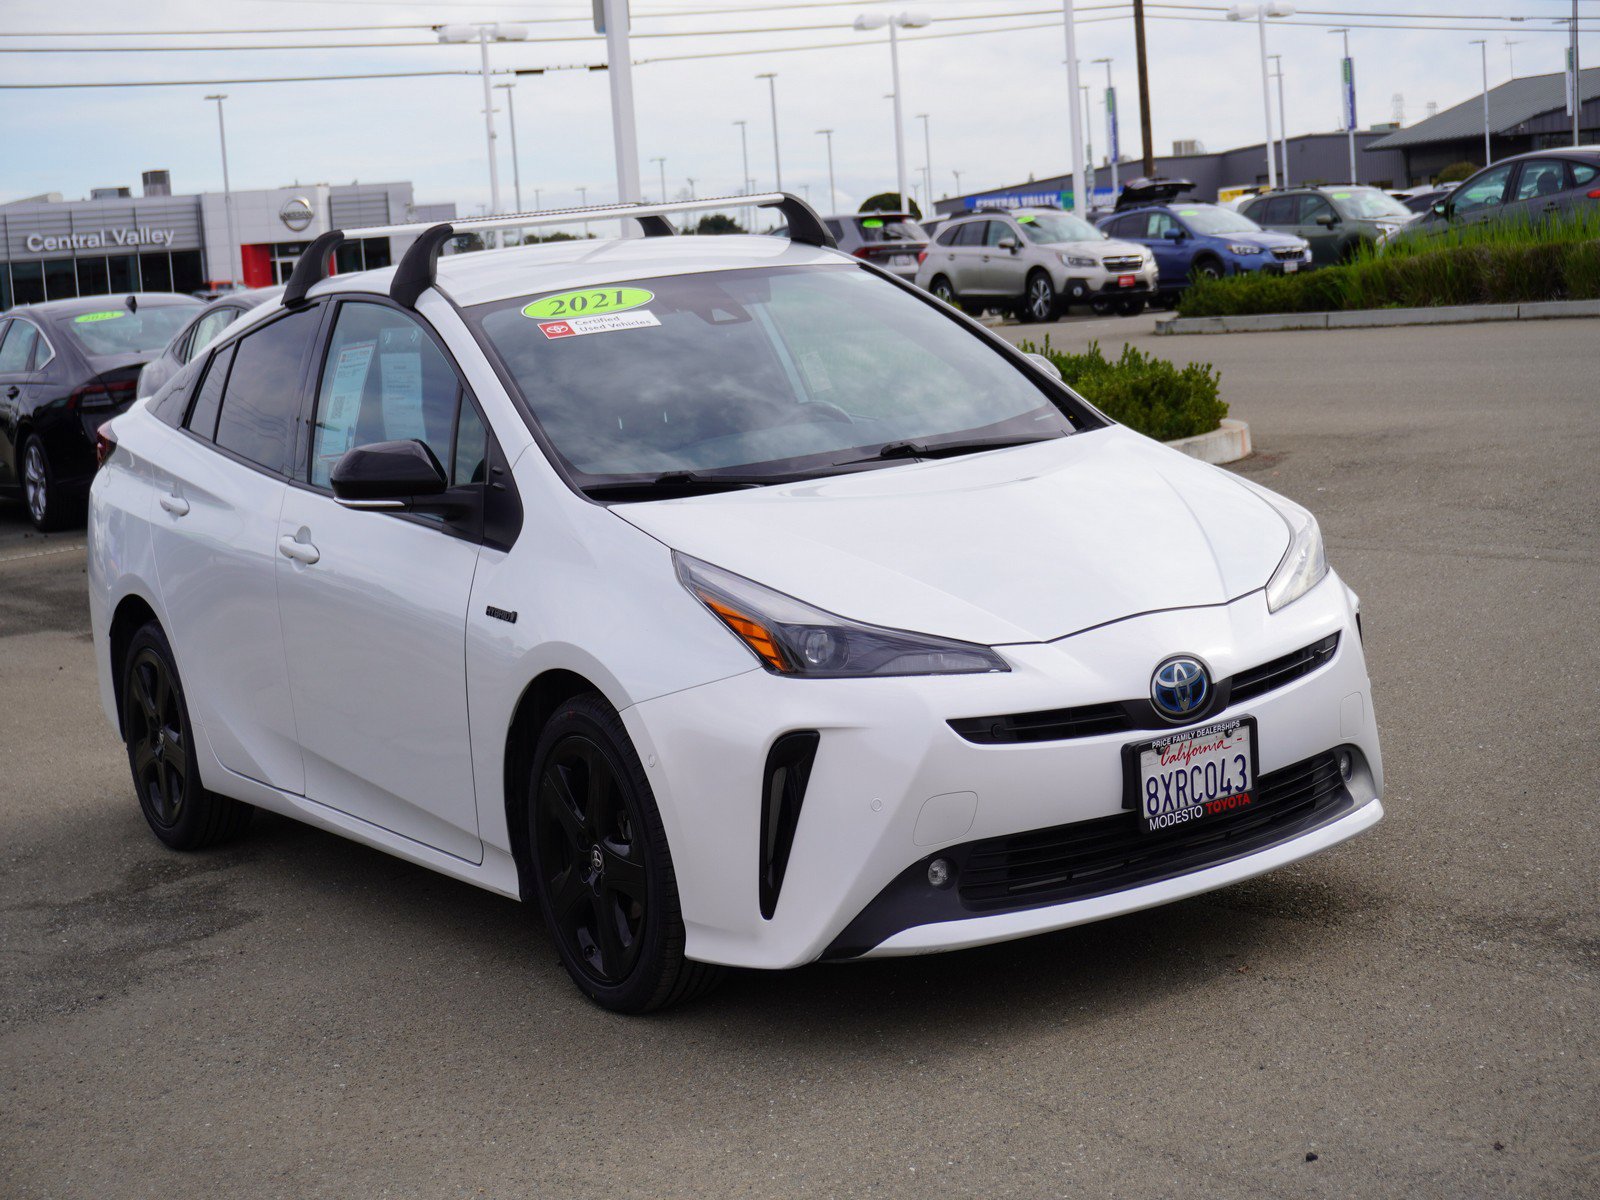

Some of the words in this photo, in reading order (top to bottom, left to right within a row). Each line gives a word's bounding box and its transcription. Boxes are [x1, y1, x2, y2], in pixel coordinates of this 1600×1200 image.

[27, 230, 105, 252] Central
[111, 226, 175, 247] Valley
[549, 290, 626, 316] 2021
[575, 316, 620, 326] Certified
[580, 324, 606, 333] Used
[610, 319, 652, 329] Vehicles
[1152, 739, 1171, 749] PRICE
[1172, 732, 1196, 744] FAMILY
[1196, 720, 1240, 738] DEALERSHIPS
[1160, 736, 1232, 766] California
[1146, 754, 1247, 815] 8XRC043
[1149, 805, 1203, 831] MODESTO
[1205, 793, 1251, 814] TOYOTA
